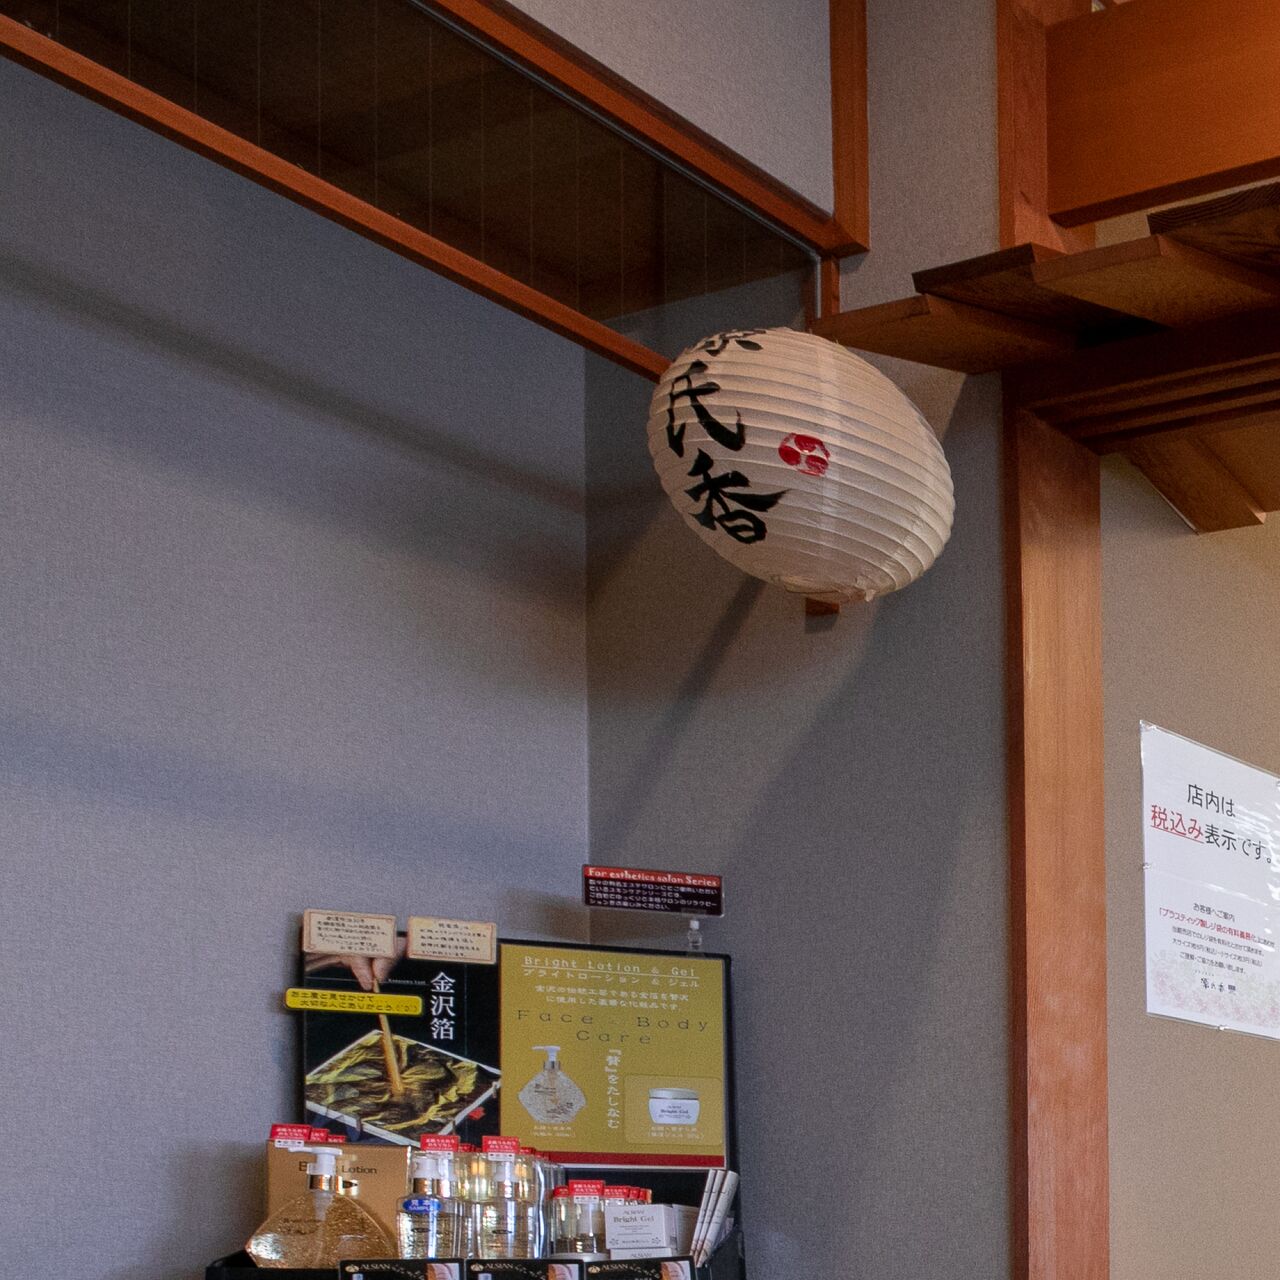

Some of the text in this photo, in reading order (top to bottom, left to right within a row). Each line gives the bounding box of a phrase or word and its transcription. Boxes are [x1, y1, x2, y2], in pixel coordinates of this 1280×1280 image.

[1187, 784, 1236, 818] 店内は
[1151, 804, 1271, 863] 税込み表示です。
[588, 867, 718, 887] For esthetics salon Series
[524, 956, 577, 969] Bright
[588, 959, 640, 973] Lotion
[671, 967, 696, 977] Gel
[430, 972, 456, 1040] 金沢箔
[516, 1009, 593, 1025] Face
[637, 1016, 708, 1033] Body
[576, 1030, 651, 1044] Care
[342, 1165, 378, 1175] Lotion
[602, 1263, 629, 1271] ALSIAN
